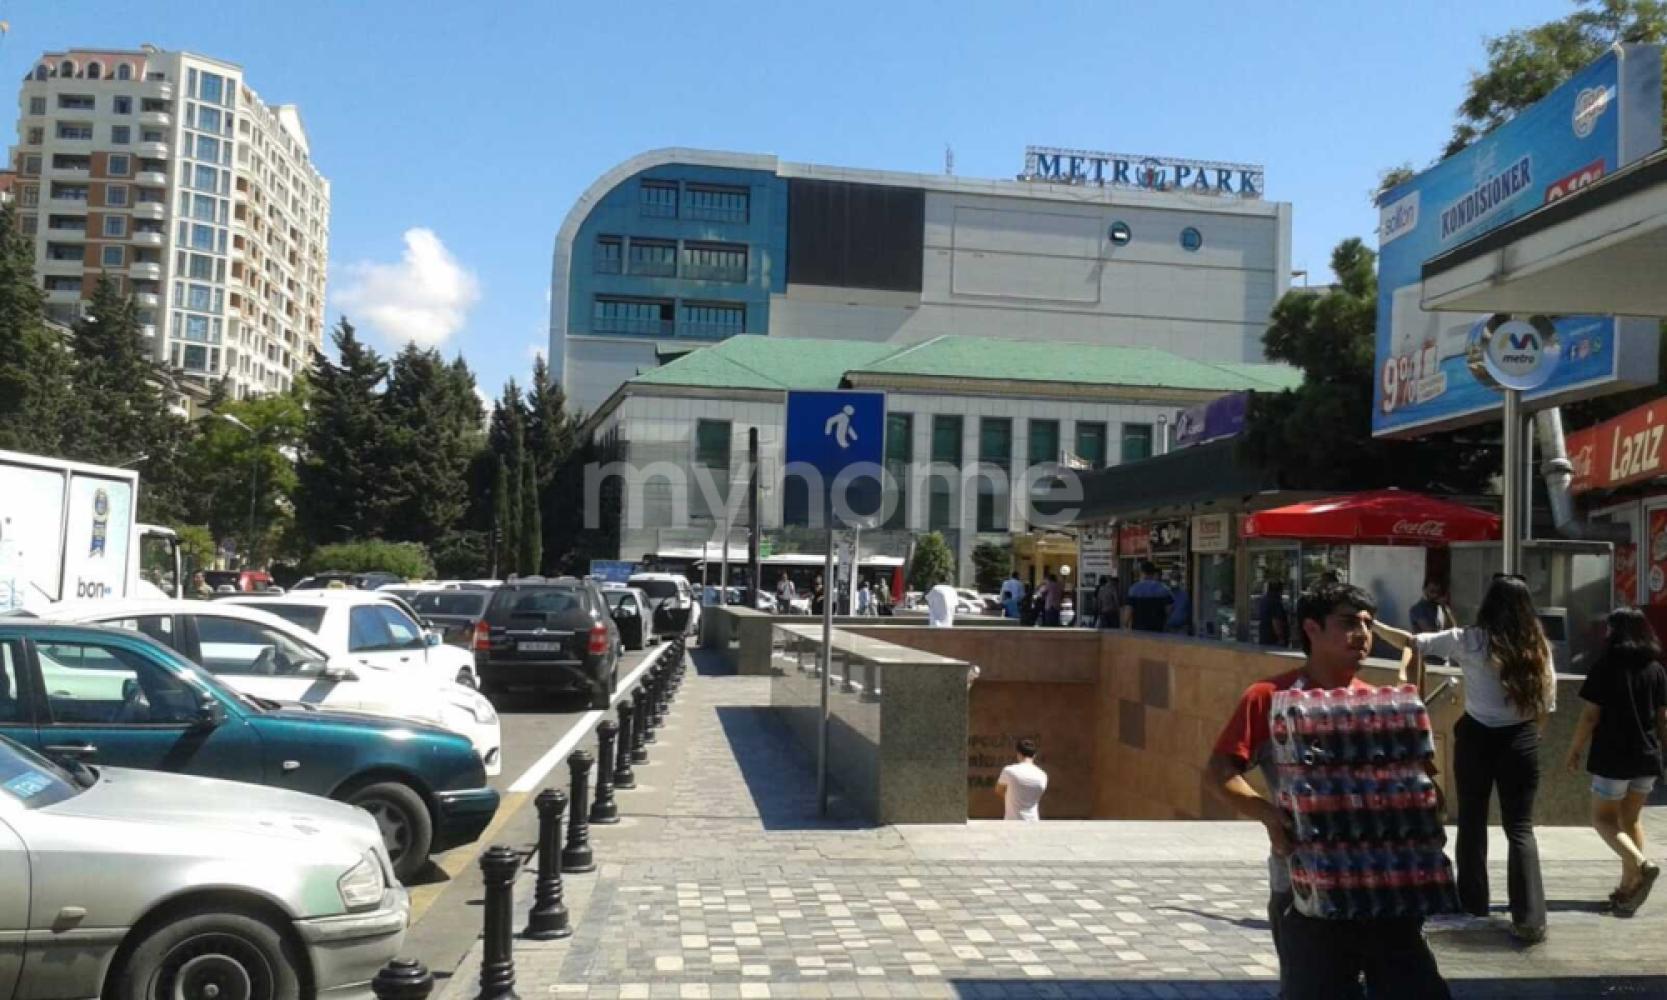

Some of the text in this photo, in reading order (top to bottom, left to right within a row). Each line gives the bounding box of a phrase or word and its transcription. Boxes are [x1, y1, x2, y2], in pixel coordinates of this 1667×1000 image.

[1502, 353, 1535, 364] metro
[1610, 409, 1665, 481] Laziz
[77, 576, 104, 598] bon
